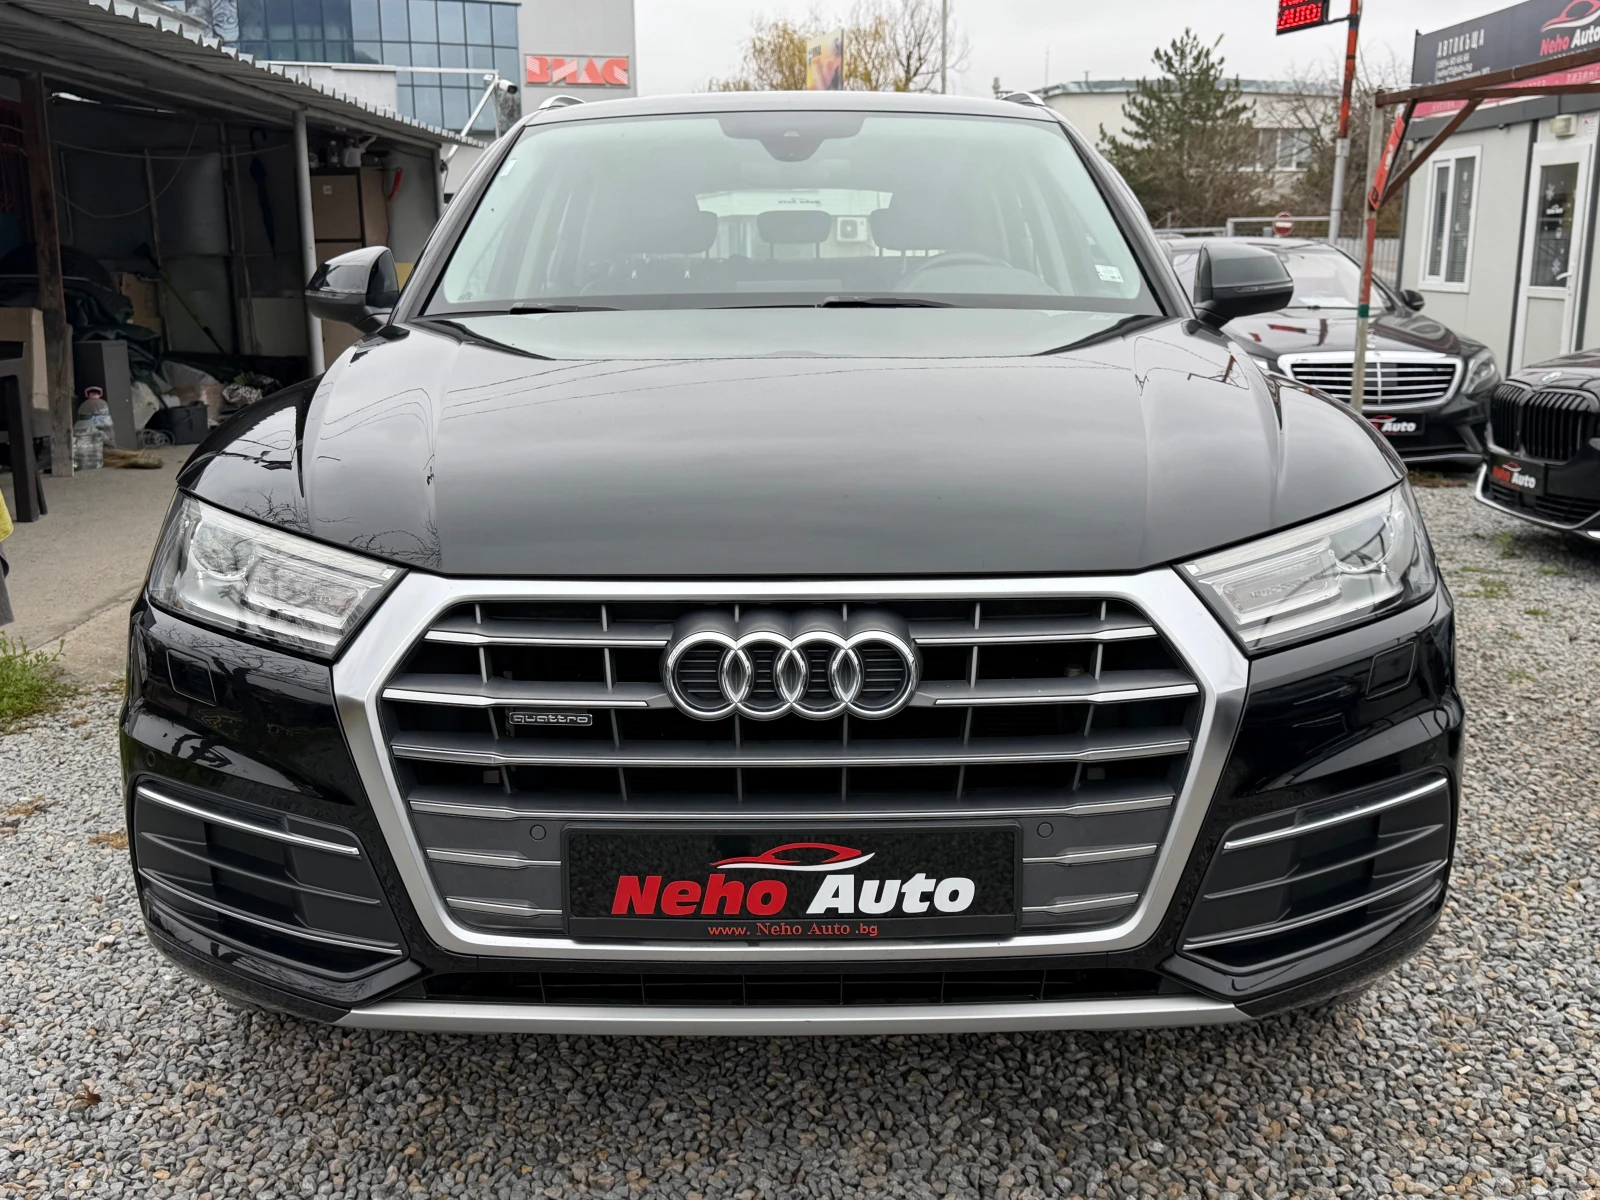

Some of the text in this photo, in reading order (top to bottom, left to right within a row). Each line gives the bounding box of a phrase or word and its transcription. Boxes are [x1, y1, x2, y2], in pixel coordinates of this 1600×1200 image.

[1436, 29, 1484, 58] АВТОКЪЩА
[1540, 33, 1570, 56] Neho
[1570, 25, 1600, 48] Auto
[526, 56, 628, 85] ВИАС
[1381, 421, 1417, 432] Auto
[1511, 472, 1536, 489] Auto
[513, 714, 588, 723] quattro
[612, 873, 976, 915] Neho Auto
[708, 922, 878, 936] www. Neho Auto .bg
